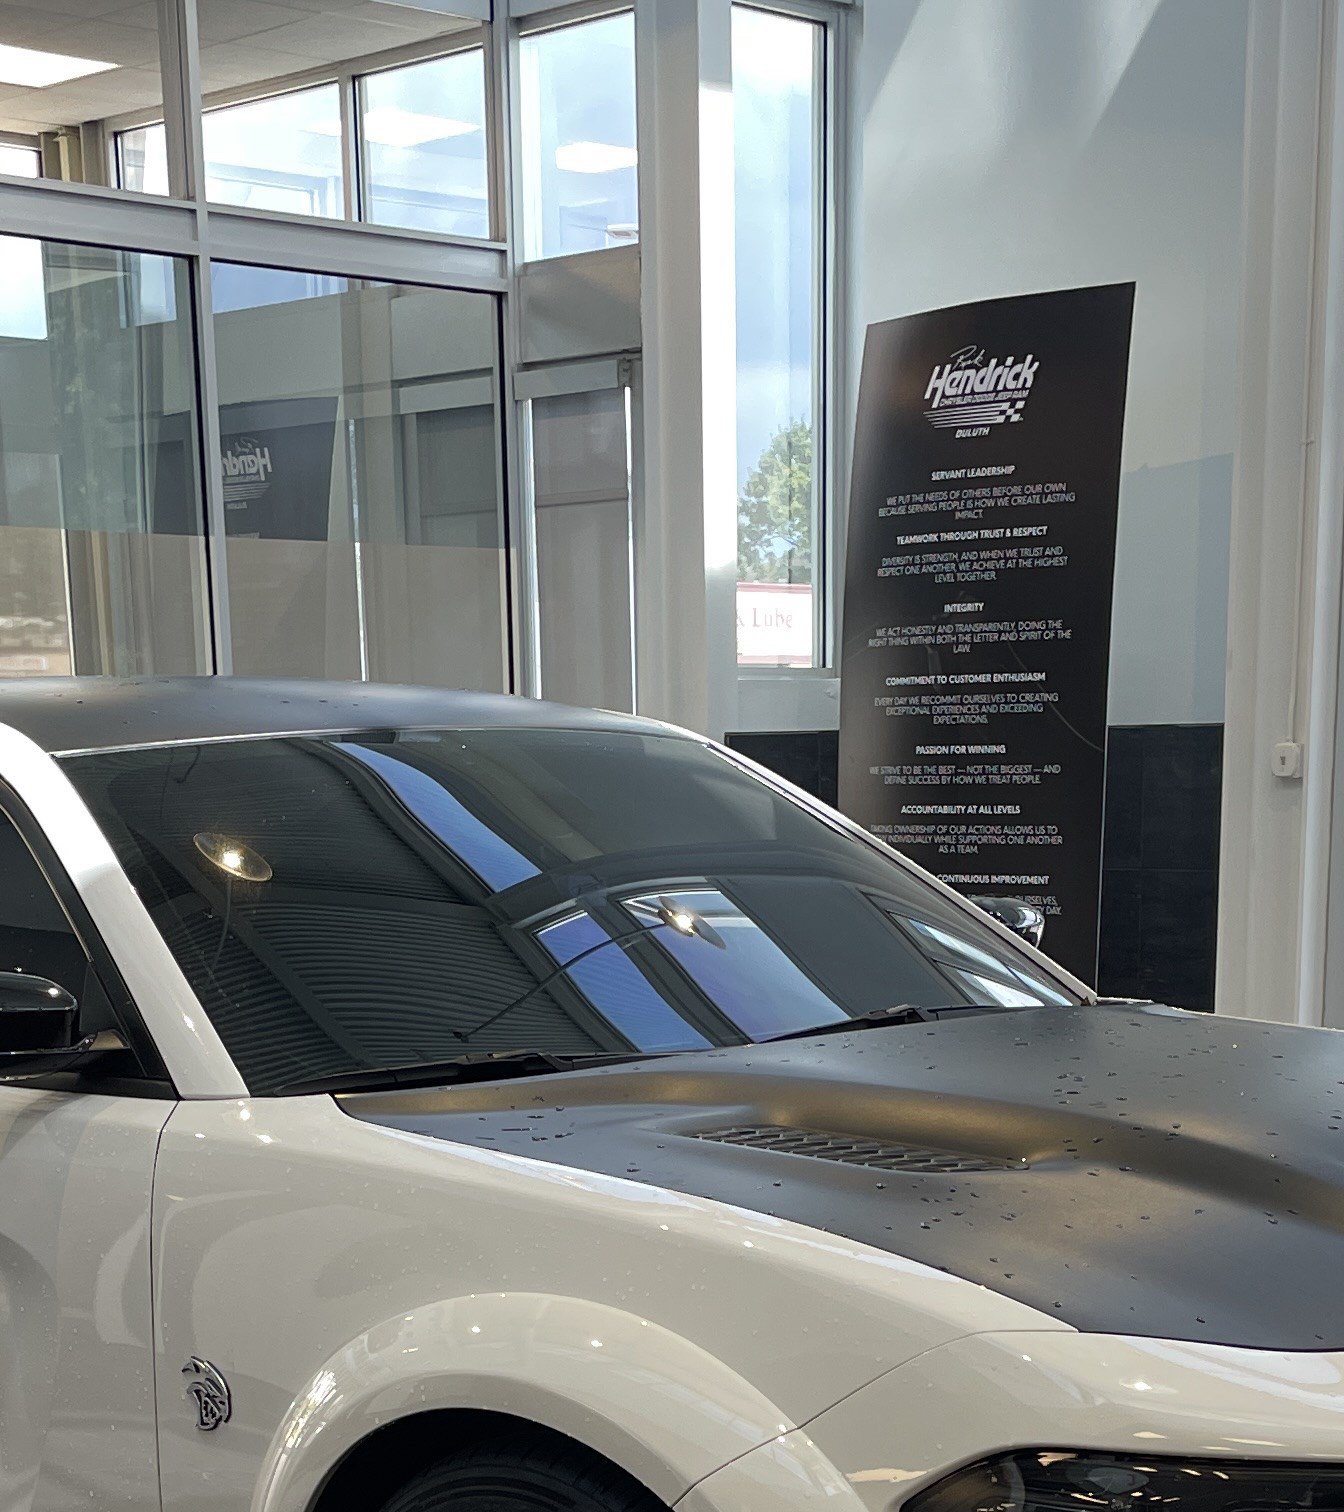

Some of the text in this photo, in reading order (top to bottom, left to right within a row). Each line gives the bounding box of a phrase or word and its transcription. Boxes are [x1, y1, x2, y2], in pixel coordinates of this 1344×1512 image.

[924, 354, 1040, 409] Hendrick
[955, 427, 990, 438] DULUTH
[931, 465, 1015, 480] SERVANT LEADERSHIP
[896, 534, 938, 544] TEAMWORK
[940, 531, 978, 542] THROUGH
[980, 529, 1004, 539] TRUST
[1013, 526, 1048, 537] RESPECT
[944, 602, 984, 612] INTEGRITY
[886, 672, 1046, 686] COMMITMENT TO CUSTOMER ENTHUSIASM
[916, 745, 1006, 754] PASSION FOR WINNING
[901, 805, 1020, 814] ACCOUNTABILITY AT ALL LEVELS
[937, 874, 1049, 884] CONTINUOUS IMPROVEMENT
